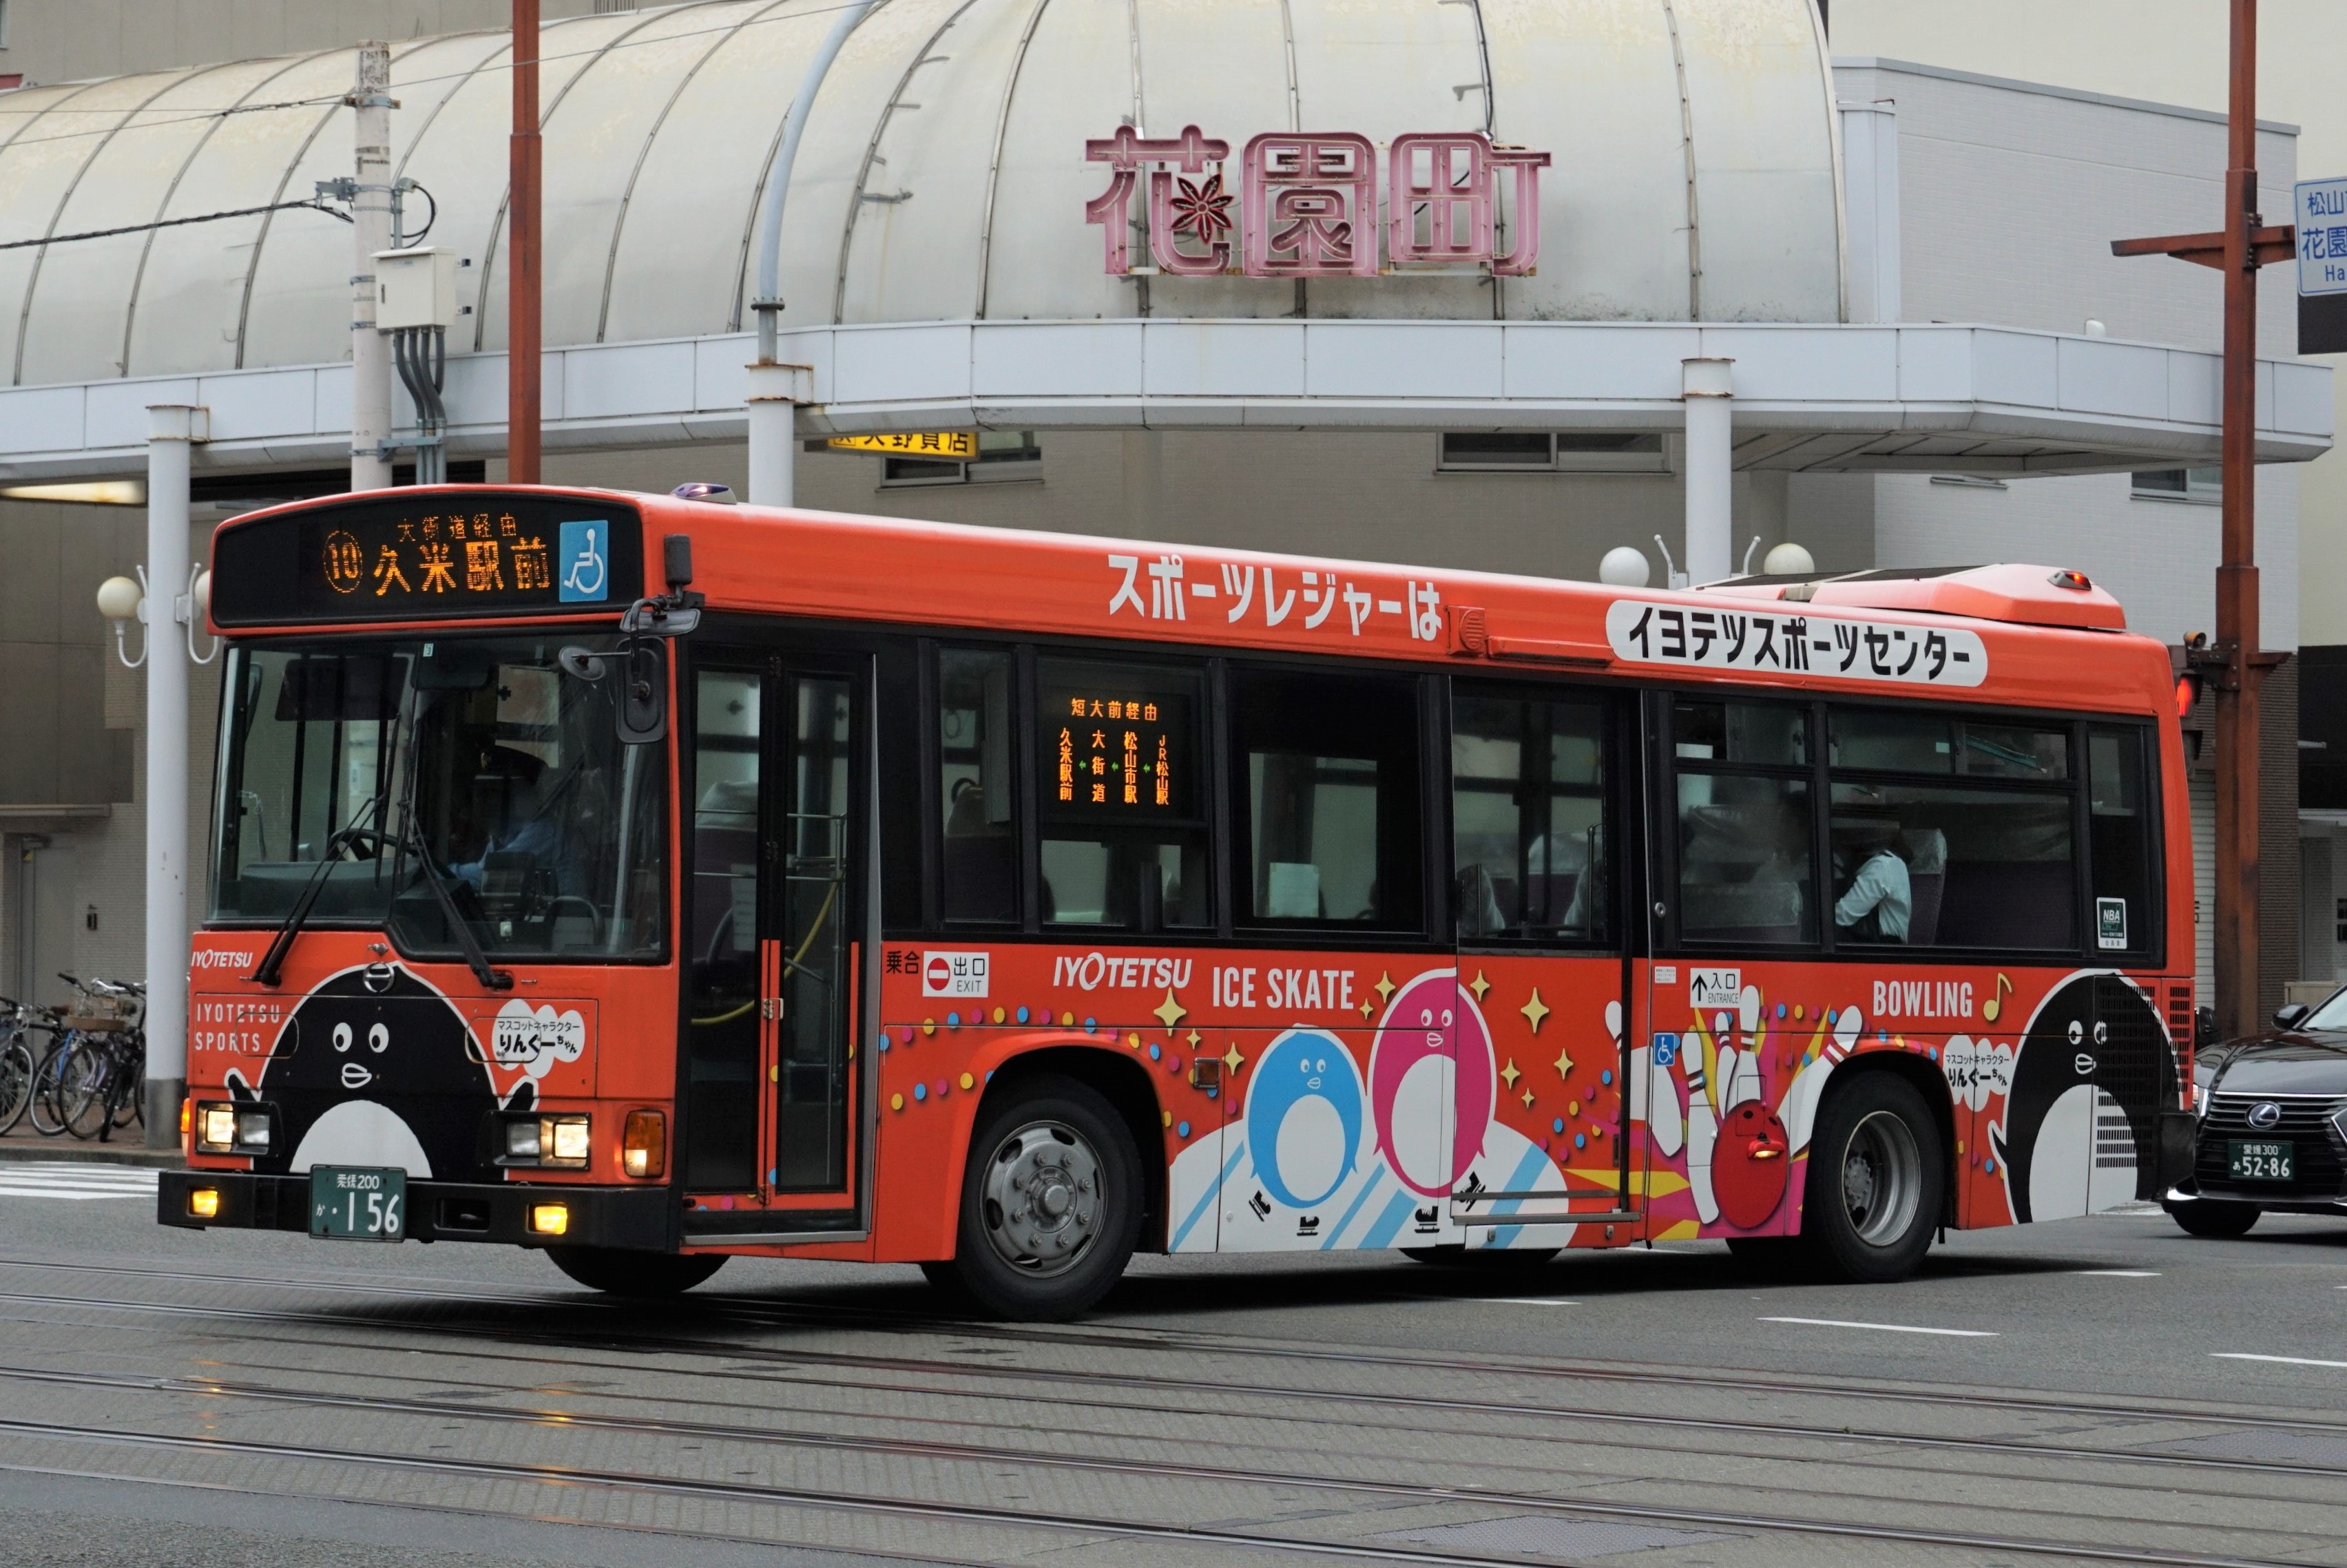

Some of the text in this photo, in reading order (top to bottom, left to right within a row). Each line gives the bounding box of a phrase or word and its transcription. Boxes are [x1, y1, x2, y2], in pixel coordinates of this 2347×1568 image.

[1086, 124, 1552, 277] 花園町
[2308, 190, 2347, 217] 松山
[397, 512, 517, 541] 大街道経由
[373, 536, 550, 596] 久米駅前
[1107, 554, 1442, 641] スポーツレジャーは
[1629, 606, 1970, 680] イヨテツスポーツセンター
[1071, 698, 1157, 721] 短大前経由
[1059, 727, 1073, 801] 久米駅前
[1092, 729, 1105, 802] 大街道
[1124, 731, 1138, 804] 松山市駅
[1156, 735, 1169, 805] JR松山駅
[2103, 909, 2120, 921] NBA
[191, 949, 253, 969] IYOTETSU
[886, 950, 920, 974] 乗合
[954, 956, 985, 976] 出口
[1053, 952, 1192, 991] IYOTETSU
[1711, 972, 1736, 990] 入口
[957, 980, 981, 992] EXIT
[1213, 967, 1355, 1010] ICE SKATE
[1708, 992, 1738, 1004] ENTRANCE
[1873, 981, 1973, 1017] BOWLING
[197, 1003, 280, 1023] IYOTETSU
[498, 1021, 580, 1032] マスコットキャラクター
[195, 1032, 260, 1052] SPORTS
[500, 1034, 577, 1054] りんぐーちゃん
[1946, 1054, 2010, 1065] マスコットキャラクター
[1948, 1067, 2007, 1087] りんぐーちゃん
[2242, 1156, 2290, 1177] 52-86
